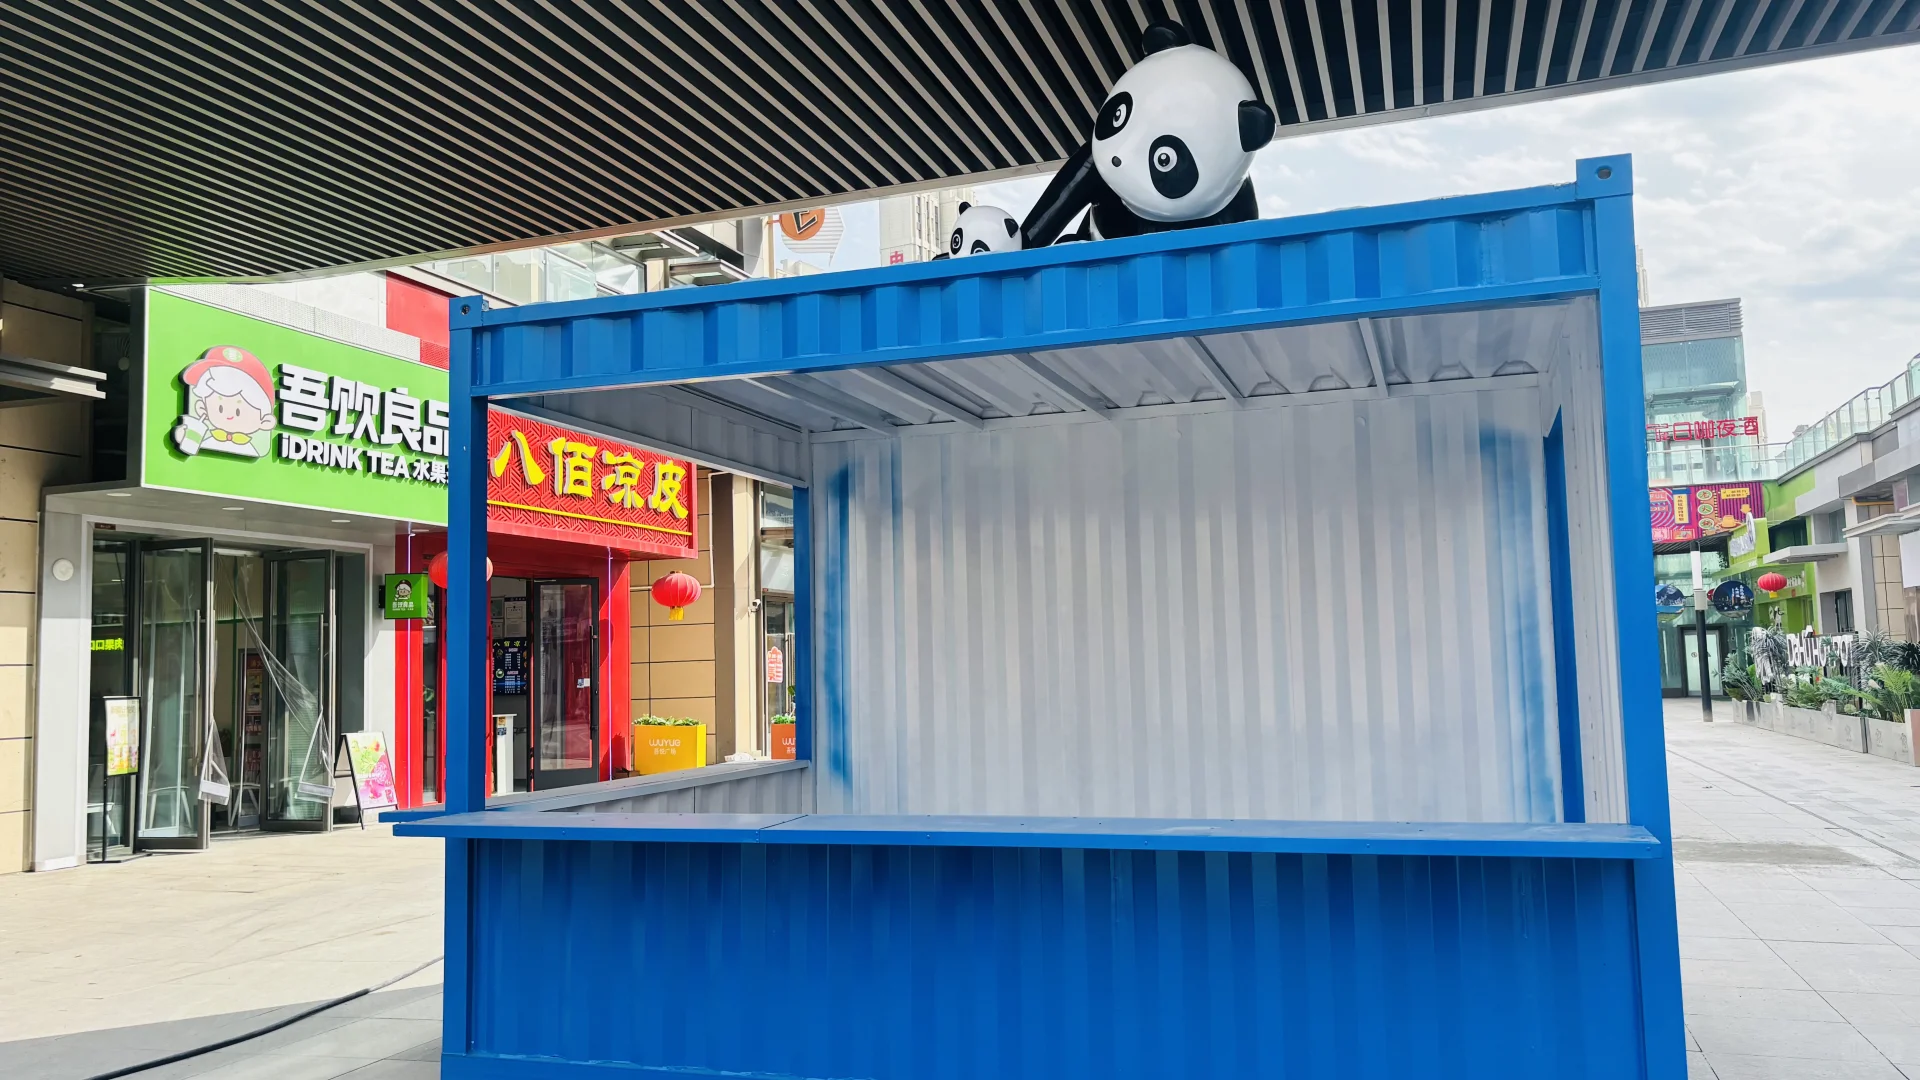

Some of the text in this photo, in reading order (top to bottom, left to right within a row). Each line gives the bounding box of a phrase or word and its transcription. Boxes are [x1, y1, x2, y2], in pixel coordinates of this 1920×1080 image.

[366, 450, 410, 479] TEA
[413, 458, 449, 484] 水果
[490, 430, 689, 519] 八佰凉皮
